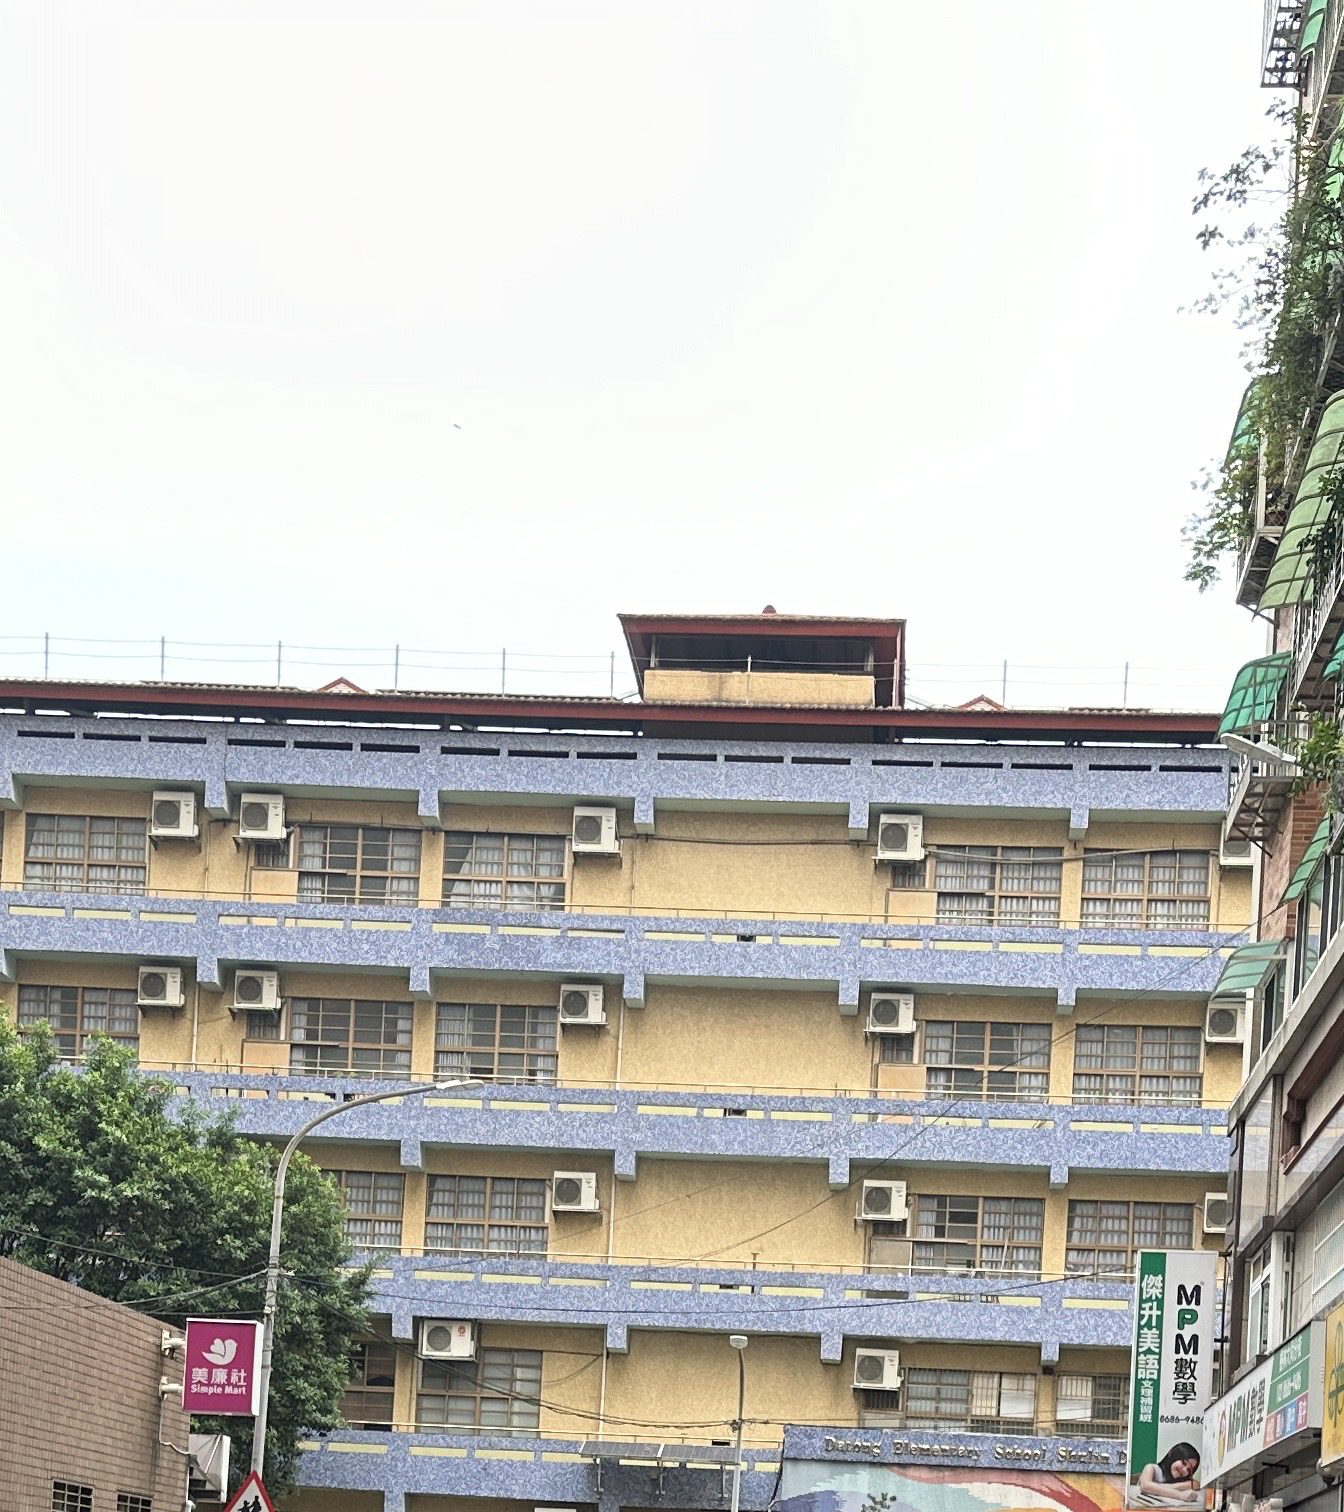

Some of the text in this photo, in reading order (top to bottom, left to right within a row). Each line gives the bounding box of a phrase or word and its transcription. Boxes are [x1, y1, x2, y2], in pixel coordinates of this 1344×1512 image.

[1137, 1274, 1164, 1380] 傑升美語
[191, 1367, 247, 1386] 美廉社
[190, 1383, 247, 1395] Simple Mart
